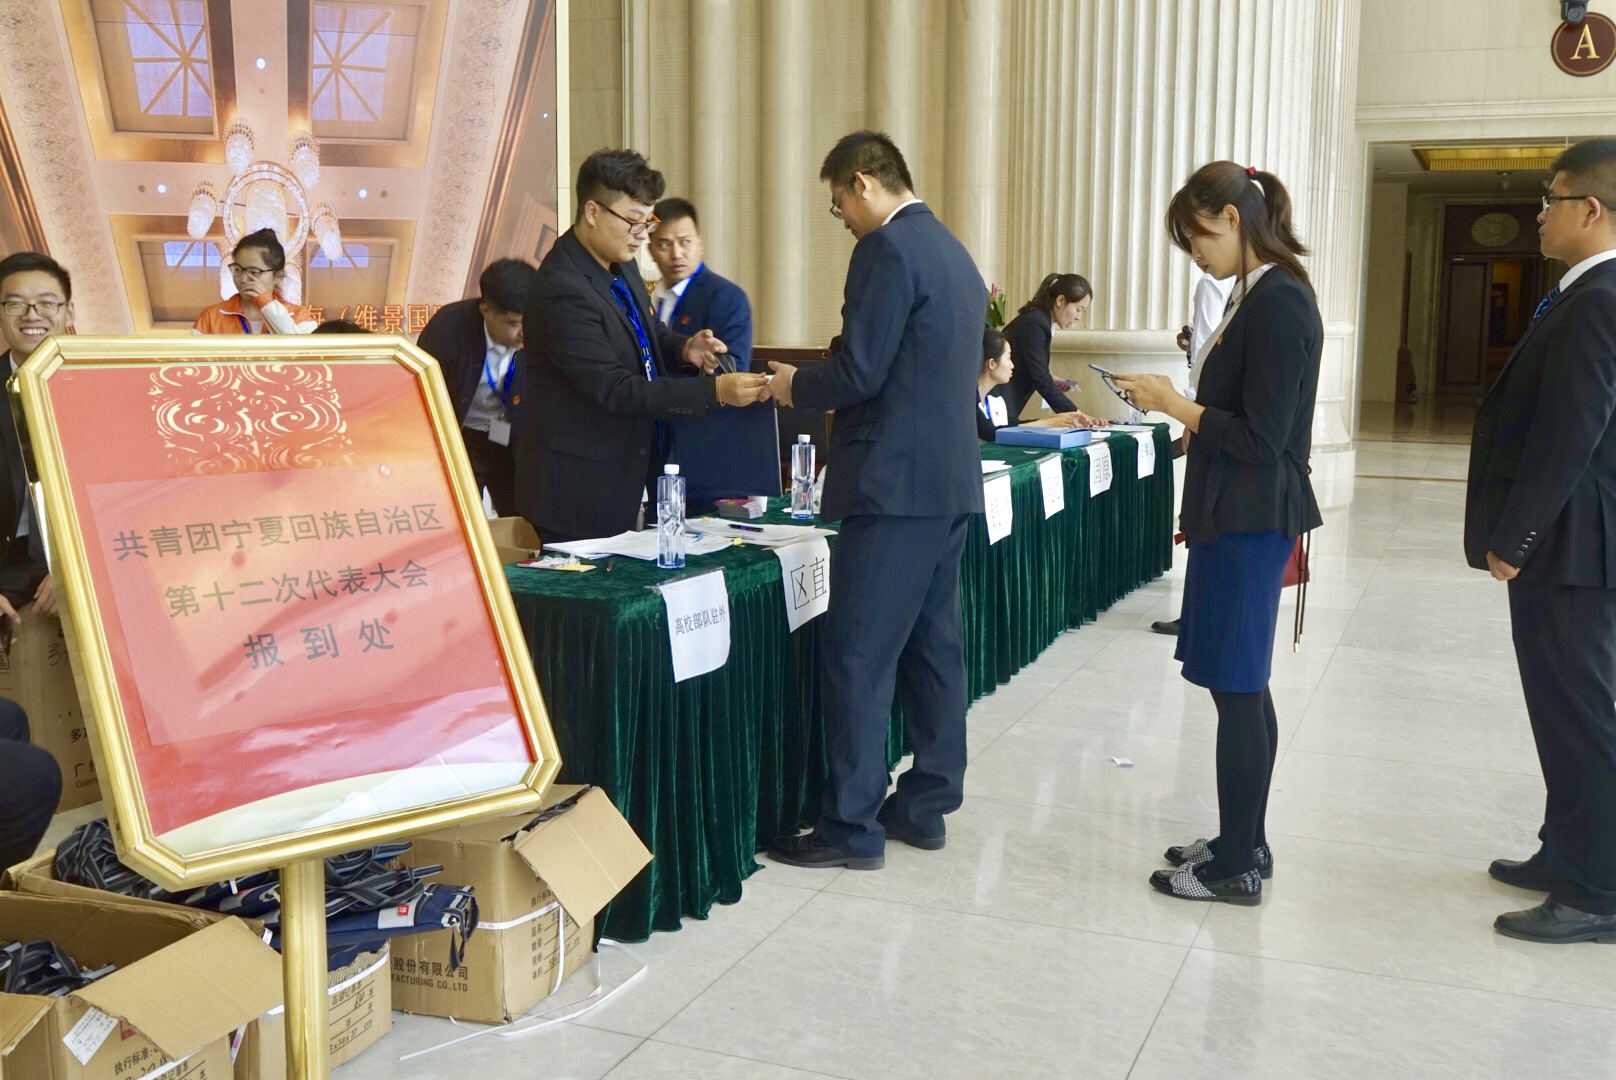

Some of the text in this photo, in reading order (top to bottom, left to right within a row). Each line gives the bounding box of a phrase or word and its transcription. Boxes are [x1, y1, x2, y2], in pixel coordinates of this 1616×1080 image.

[1569, 23, 1600, 60] A
[113, 503, 444, 562] 共青团宁夏回族自治区
[164, 559, 429, 618] 第十二次代表大会
[790, 557, 827, 611] 区直
[674, 605, 726, 636] 高校部队驻外
[243, 617, 394, 670] 报到处
[391, 973, 434, 988] FACTURING
[394, 957, 468, 980] 股份有限公司
